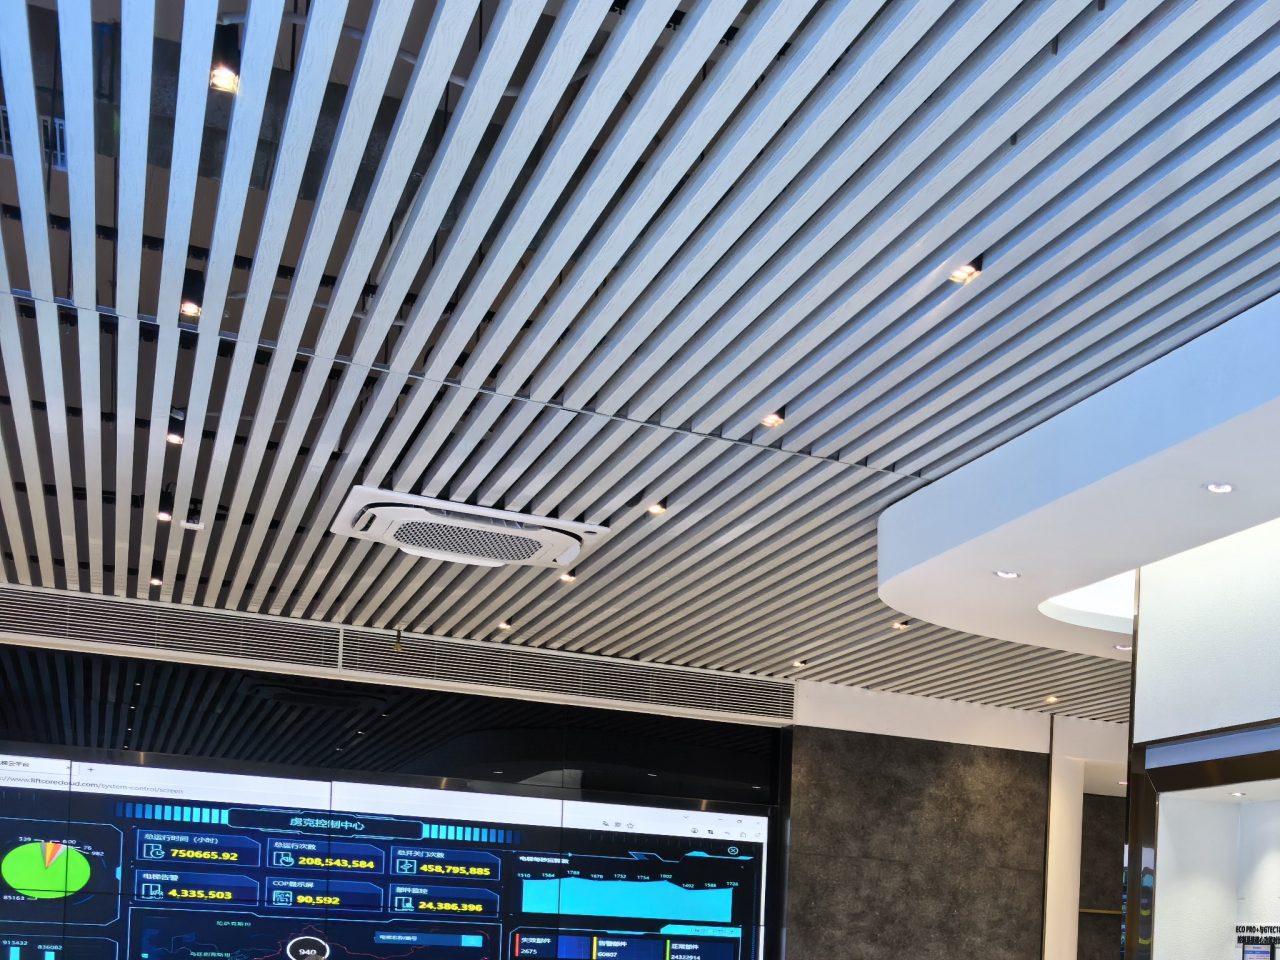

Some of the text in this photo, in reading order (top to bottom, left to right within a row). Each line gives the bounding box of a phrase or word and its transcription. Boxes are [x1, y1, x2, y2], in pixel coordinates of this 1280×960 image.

[170, 848, 239, 862] 750665.92
[298, 856, 375, 870] 208,543,584
[419, 863, 491, 877] 458,795,885
